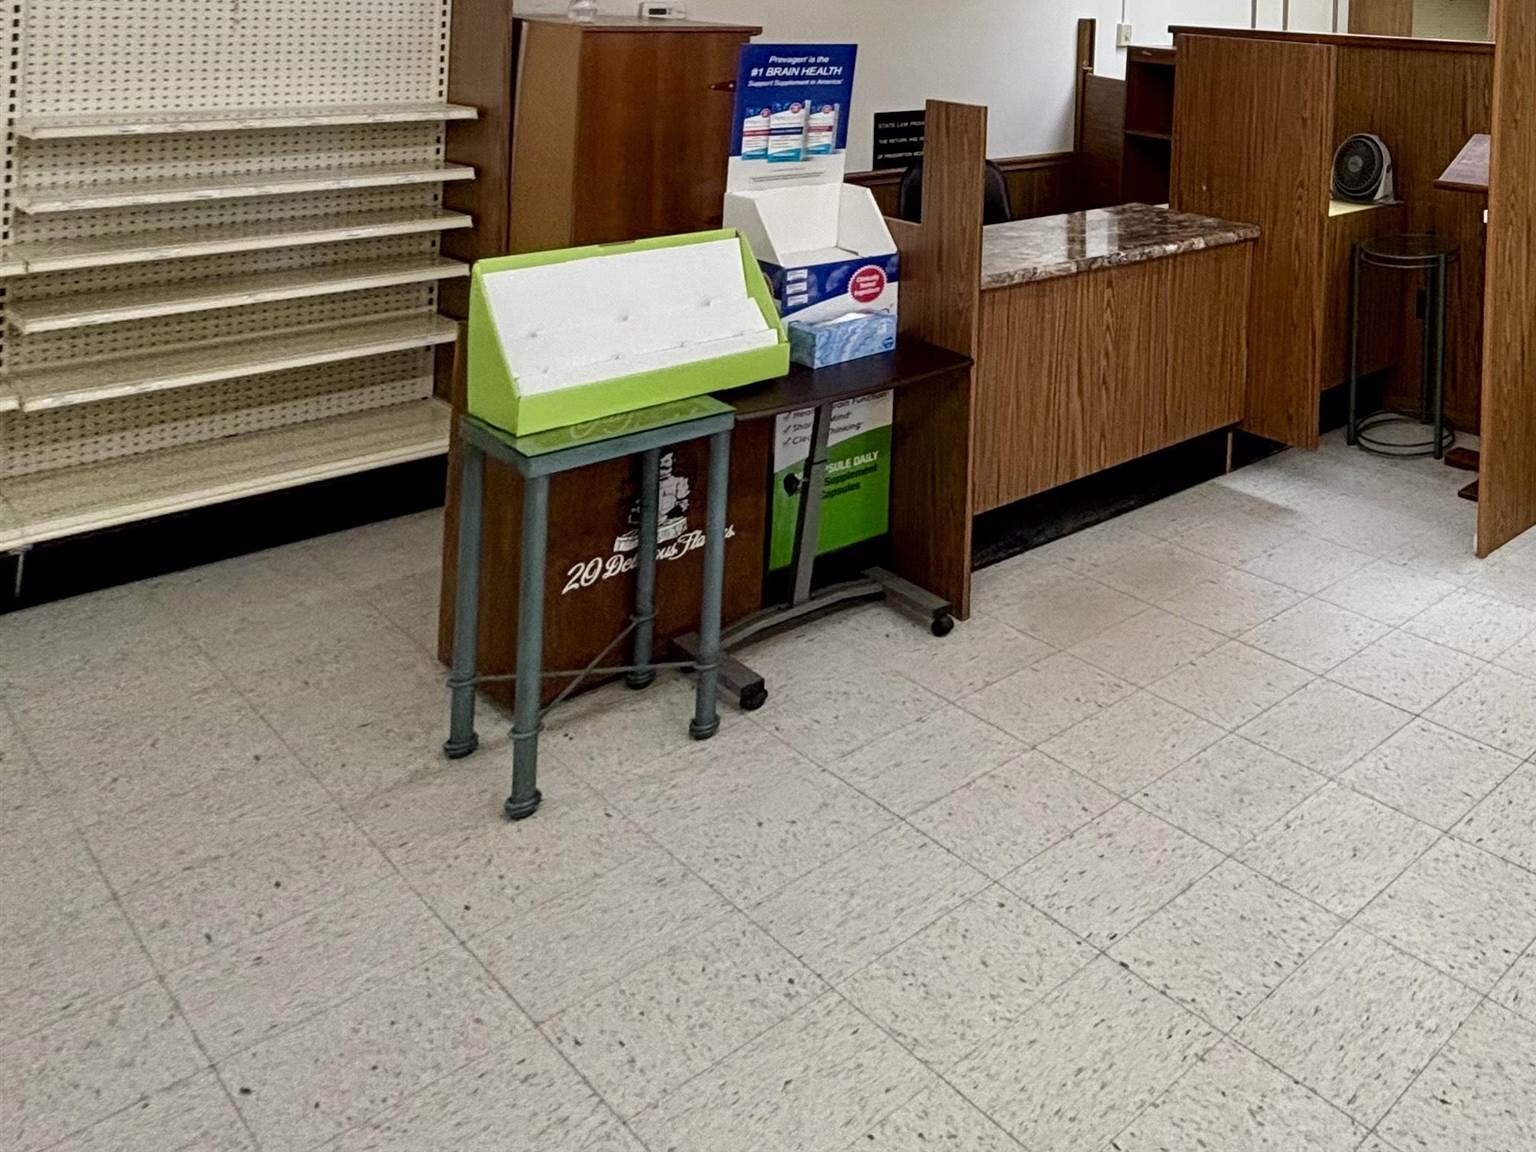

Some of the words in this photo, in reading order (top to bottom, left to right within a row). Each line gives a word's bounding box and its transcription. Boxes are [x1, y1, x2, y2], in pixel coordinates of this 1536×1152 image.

[750, 67, 763, 77] #1
[765, 66, 800, 77] BRAIN
[800, 66, 843, 76] HEALTH
[853, 450, 879, 467] DAILY
[561, 556, 603, 595] 20
